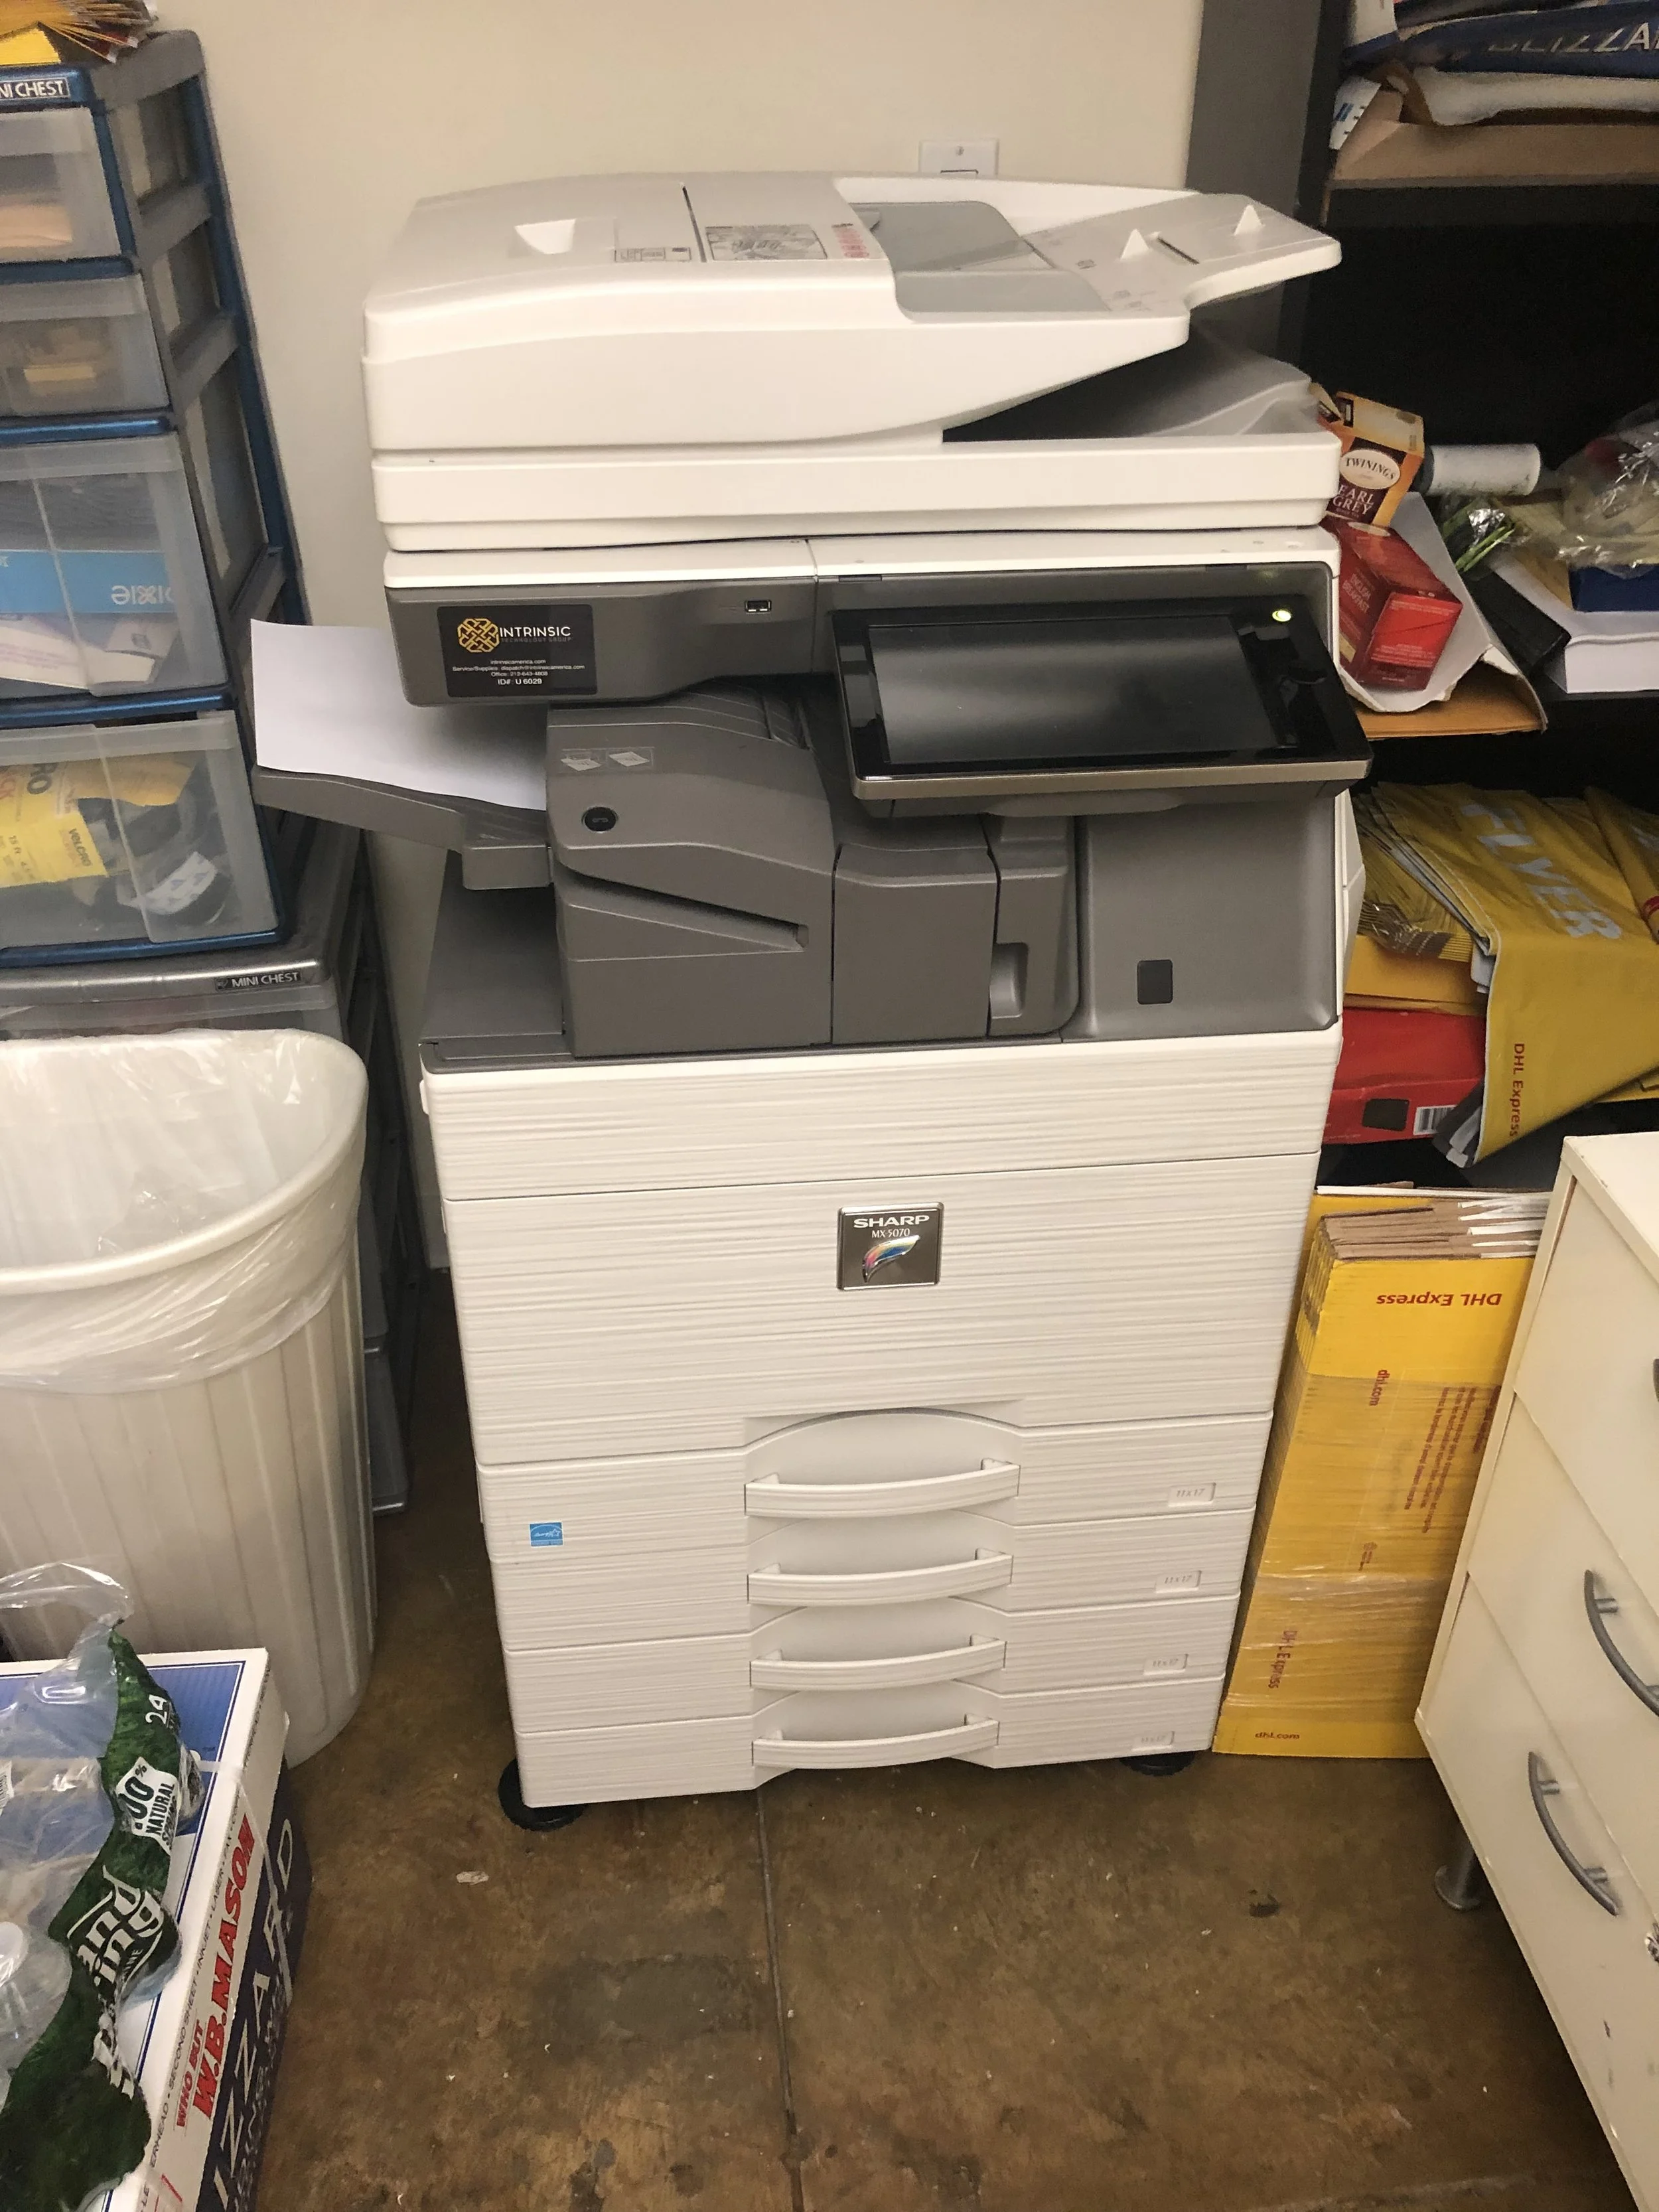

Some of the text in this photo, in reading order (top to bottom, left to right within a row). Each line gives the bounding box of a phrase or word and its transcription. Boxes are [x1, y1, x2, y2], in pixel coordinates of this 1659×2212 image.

[15, 80, 64, 98] CHEST
[1345, 457, 1397, 480] TWININGS
[1333, 496, 1372, 515] GREY
[1338, 484, 1374, 506] EARL
[499, 626, 571, 638] INTRINSIC
[231, 972, 299, 988] MINI CHEST
[1508, 1043, 1525, 1138] DHL Express
[853, 1215, 930, 1228] SHARP
[1376, 1291, 1502, 1306] DHL Express
[1368, 1368, 1391, 1407] dhl.com
[145, 1694, 167, 1725] 24
[1254, 1732, 1301, 1740] dhl.com
[145, 1783, 175, 1836] NATURAL
[196, 1927, 210, 1970] INKJET
[176, 2019, 203, 2127] WHO BUT
